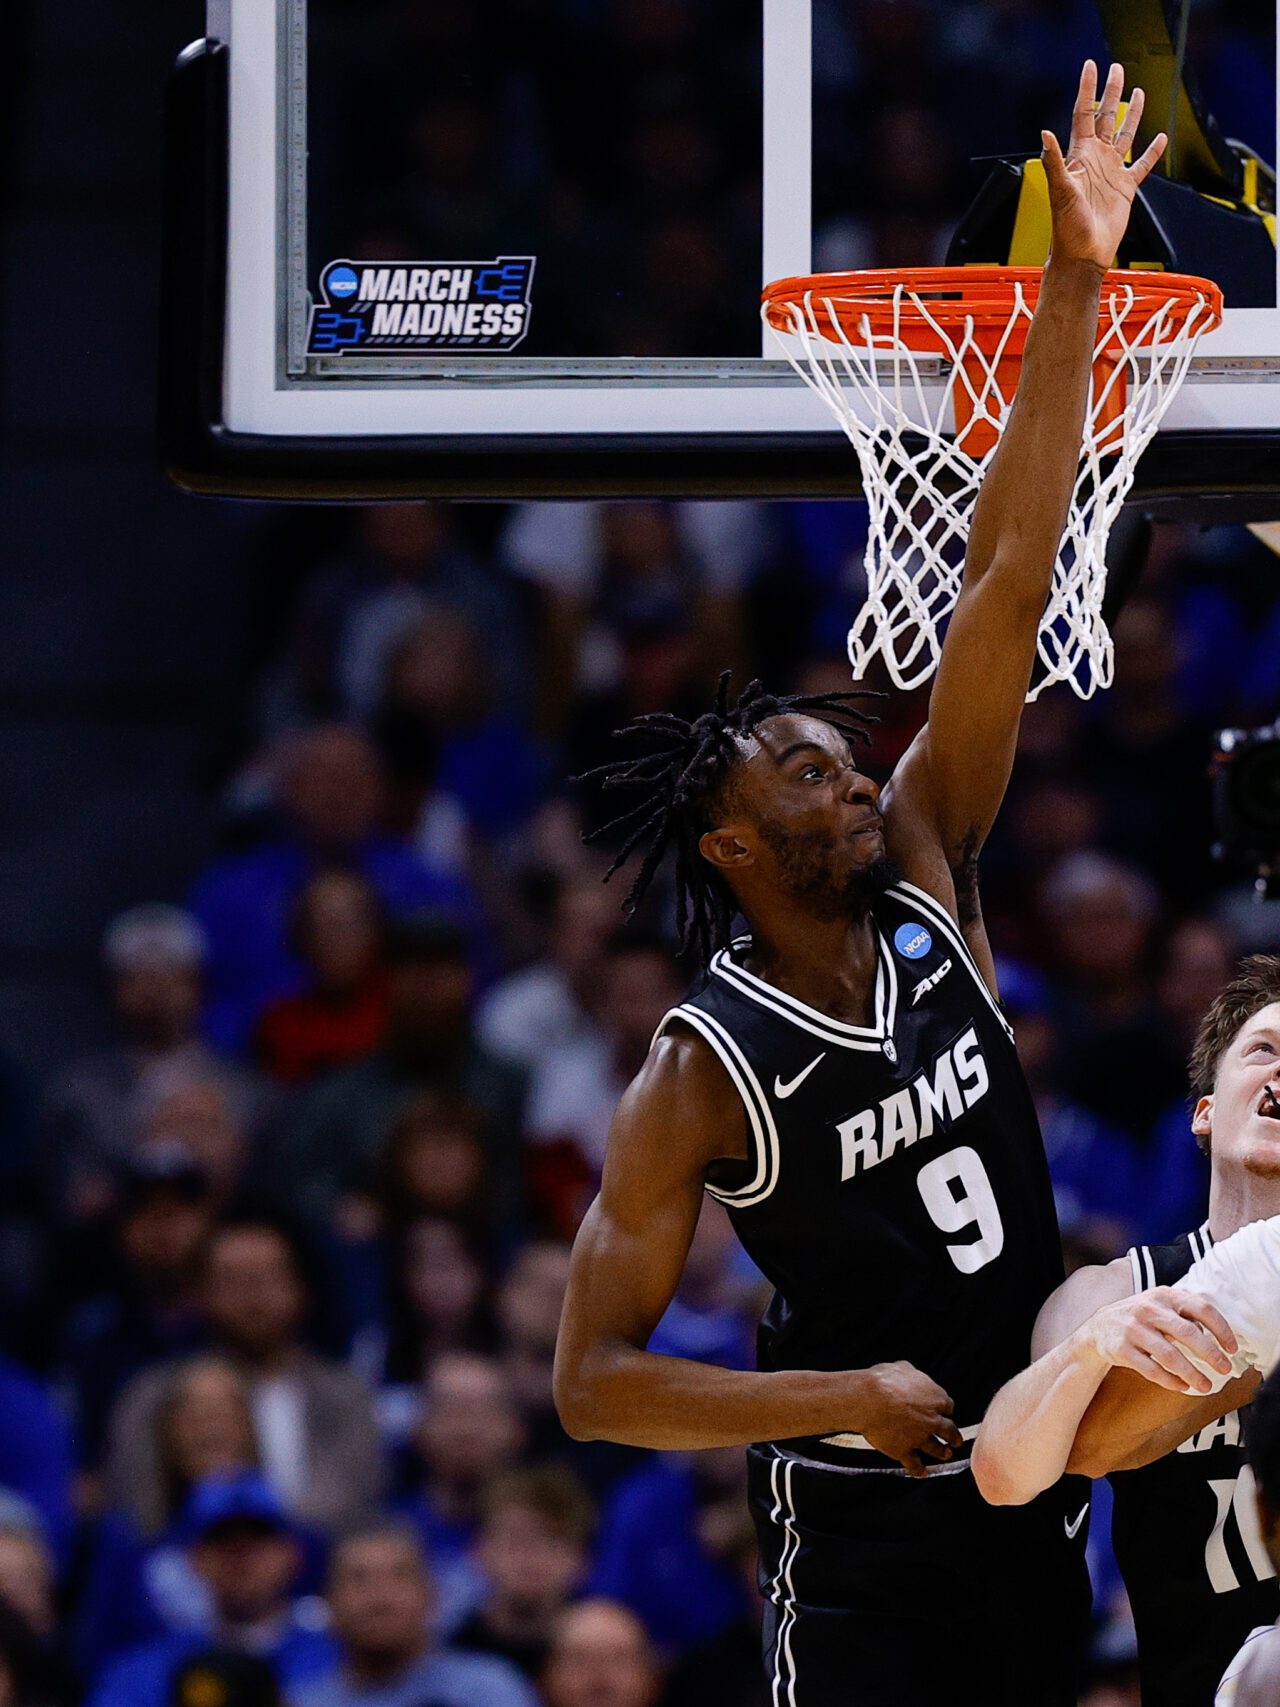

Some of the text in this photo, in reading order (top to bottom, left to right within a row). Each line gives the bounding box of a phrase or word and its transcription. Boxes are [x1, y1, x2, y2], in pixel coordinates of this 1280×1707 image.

[357, 269, 473, 301] MARCH
[370, 303, 526, 335] MADNESS
[903, 931, 930, 955] NCAA
[911, 958, 952, 1007] A10
[835, 1026, 990, 1182] RAMS
[916, 1145, 1004, 1274] 9
